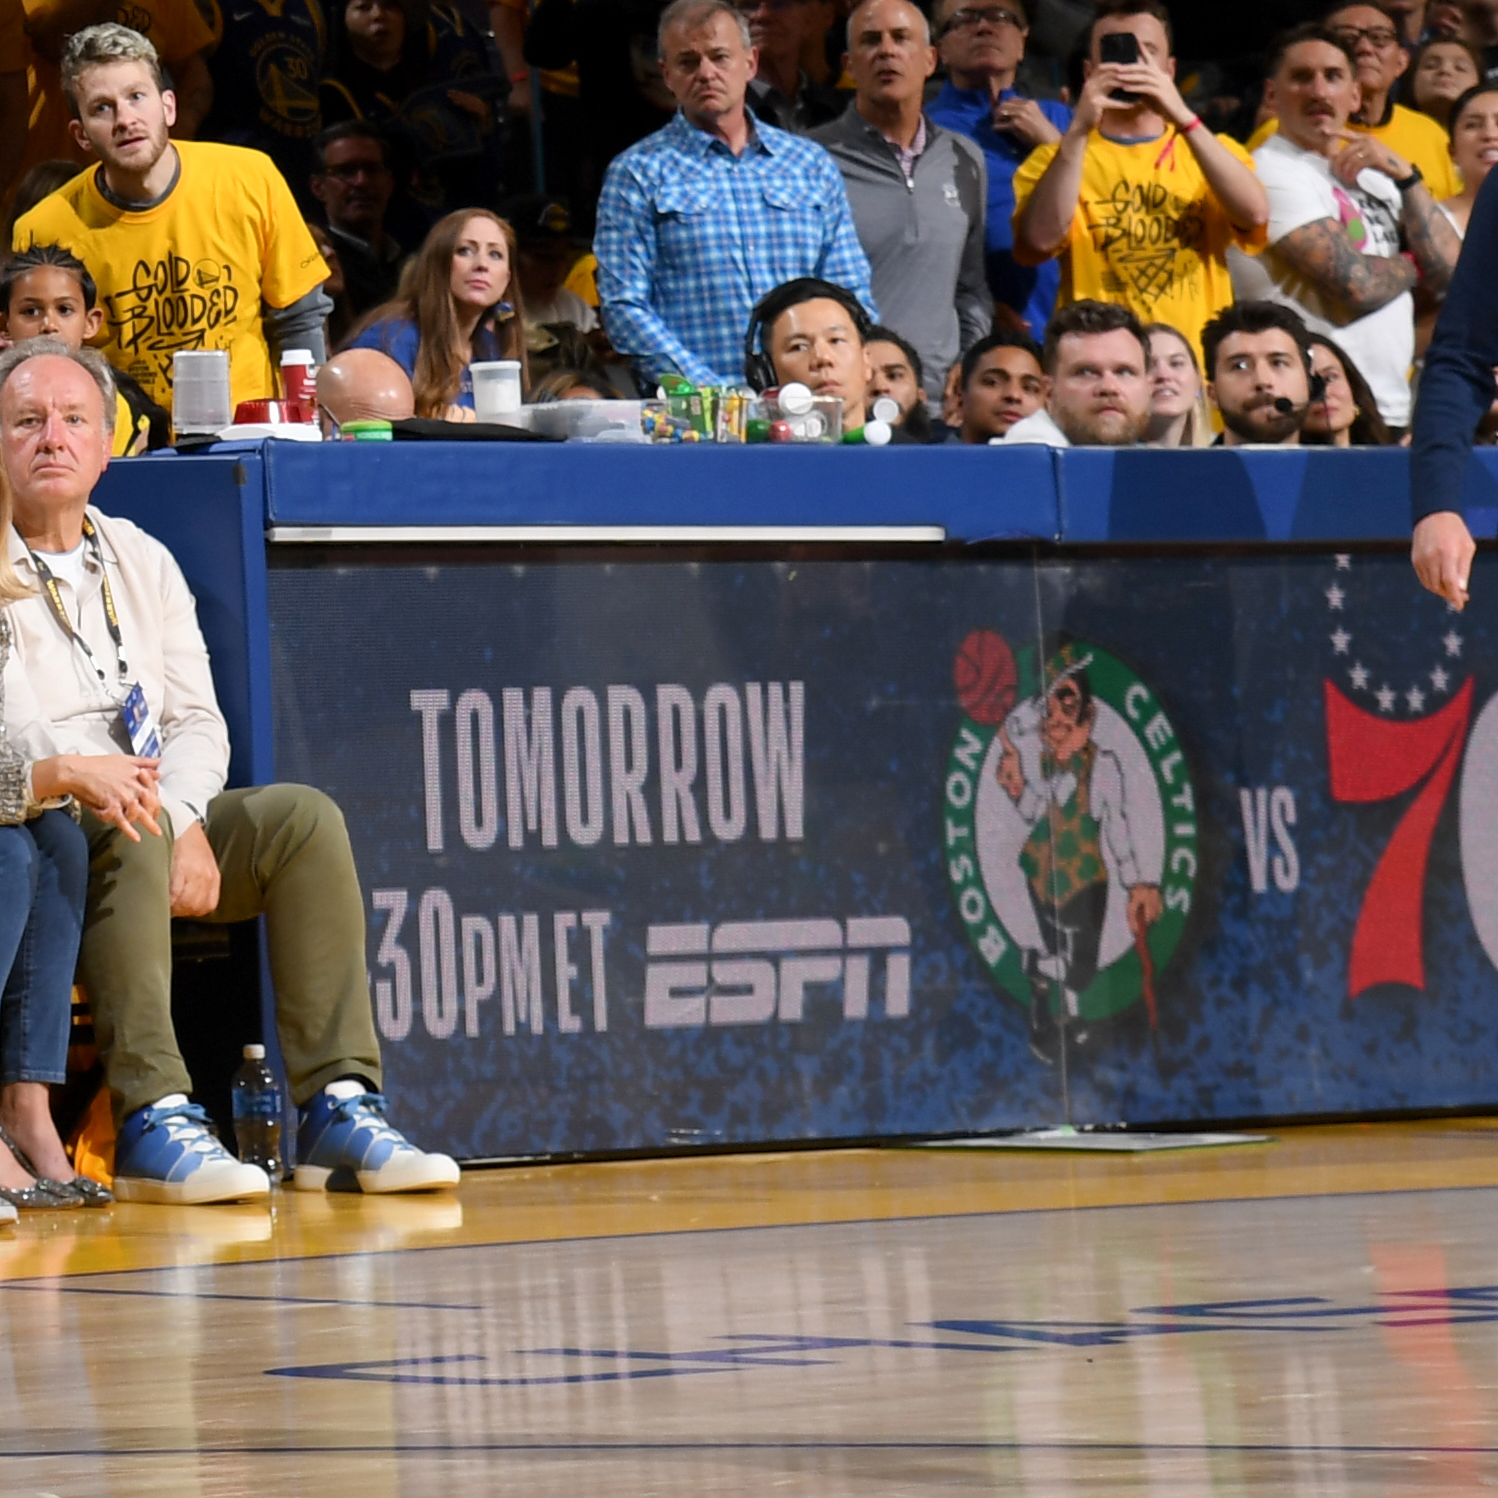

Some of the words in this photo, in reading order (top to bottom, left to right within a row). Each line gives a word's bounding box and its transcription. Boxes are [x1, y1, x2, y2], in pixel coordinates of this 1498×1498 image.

[286, 56, 308, 80] 30
[1096, 181, 1168, 216] GOLD
[114, 287, 240, 351] BLOODED
[116, 251, 192, 302] GOLD
[409, 680, 807, 853] TOMORROW
[1125, 683, 1198, 914] CELTICS
[946, 728, 1007, 965] BOSTON
[1238, 786, 1300, 894] VS
[553, 907, 612, 1034] ET
[644, 915, 913, 1028] ESPN
[263, 1285, 1498, 1386] CHAS
